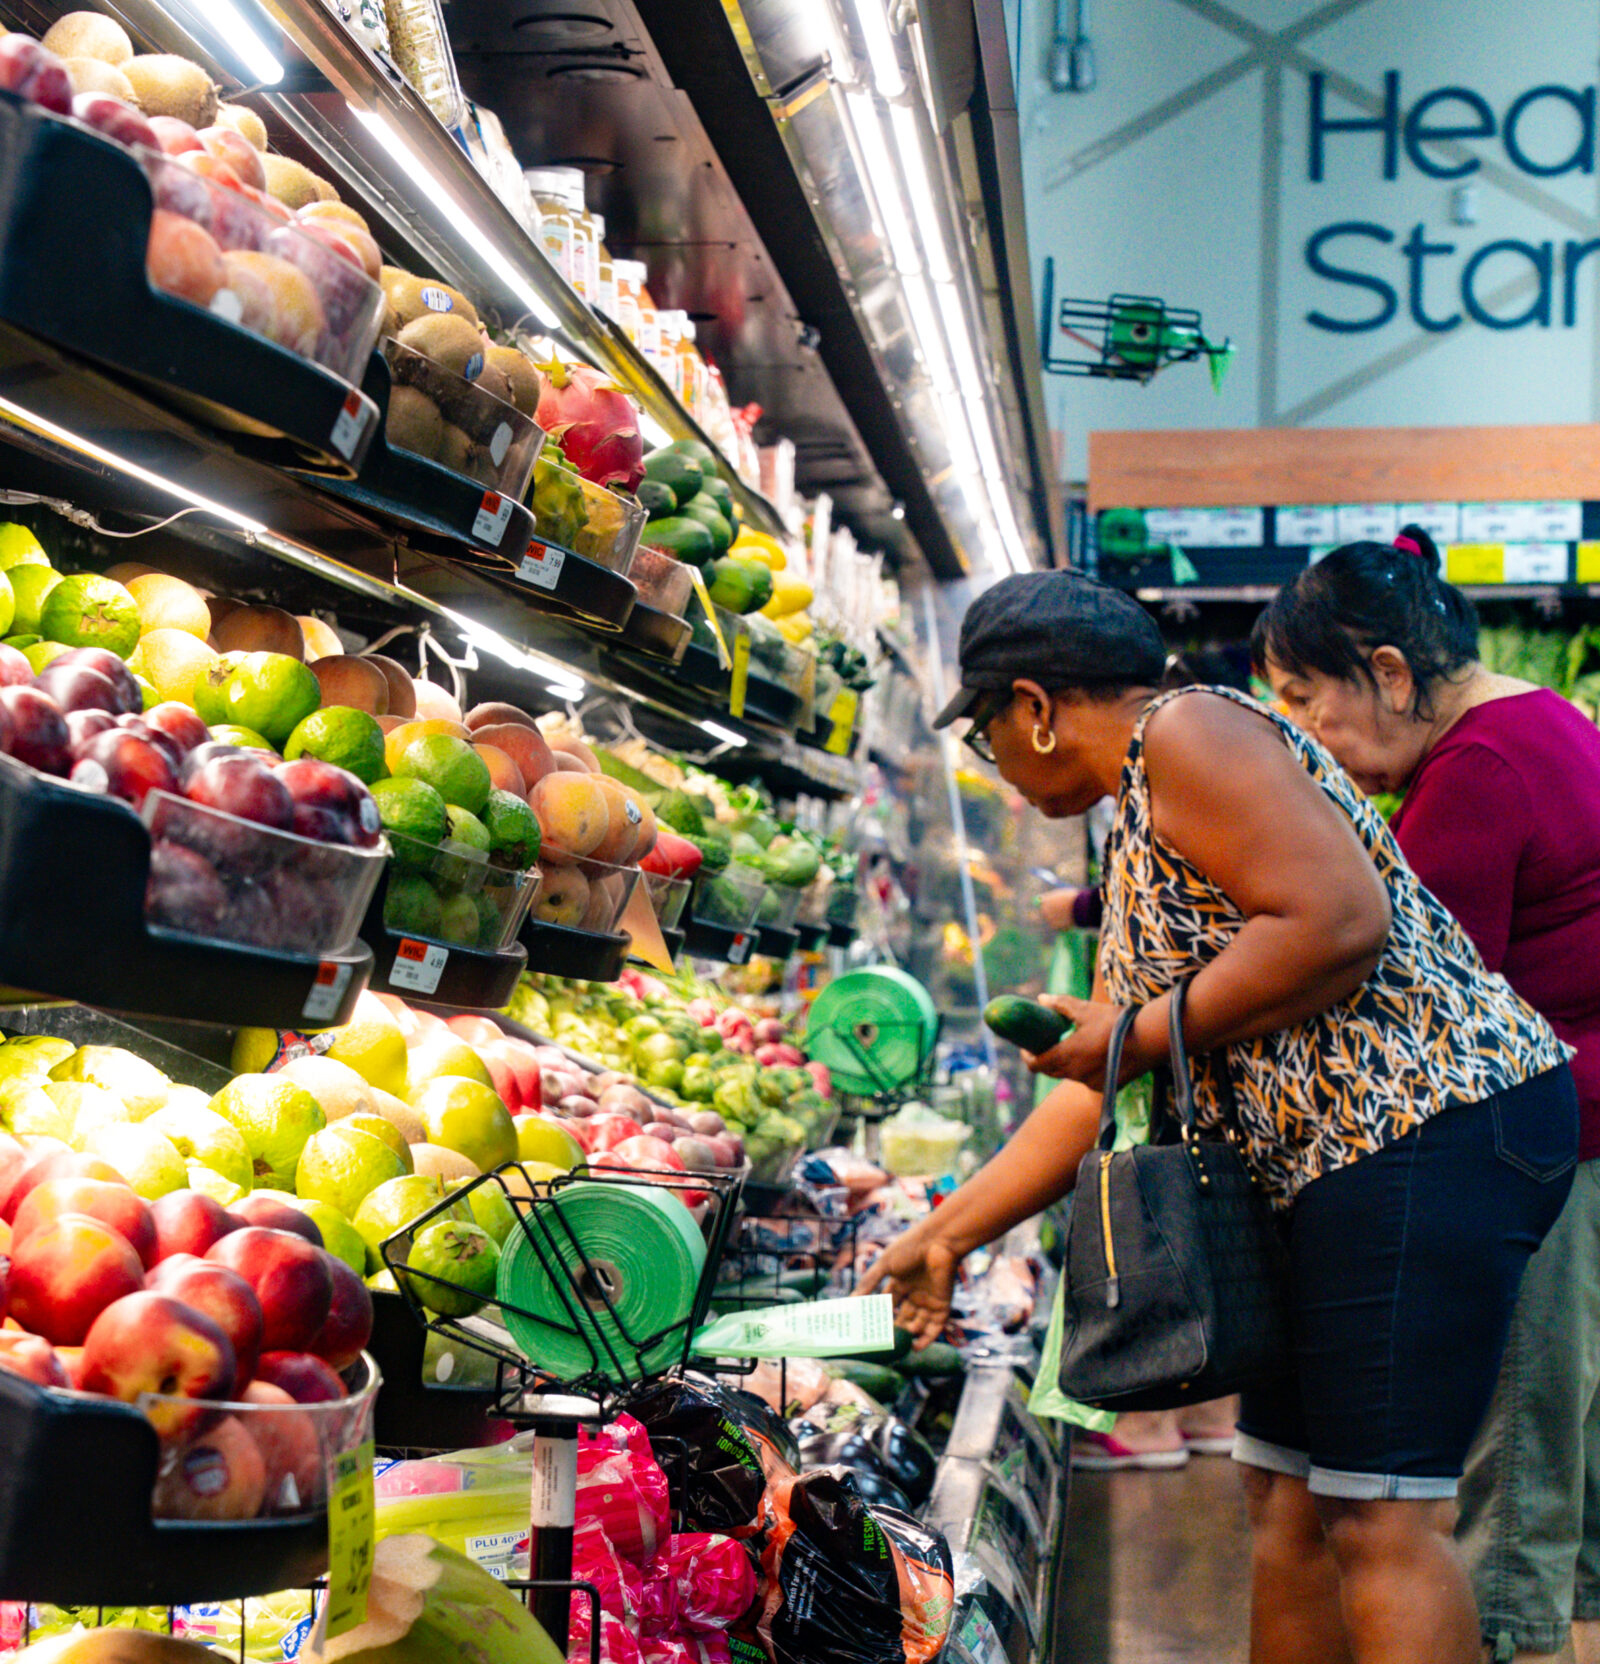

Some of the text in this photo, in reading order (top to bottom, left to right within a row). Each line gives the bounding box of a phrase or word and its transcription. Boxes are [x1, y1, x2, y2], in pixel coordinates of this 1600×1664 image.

[1309, 69, 1597, 182] Hea
[403, 943, 425, 958] WIC
[475, 1538, 498, 1549] PLU
